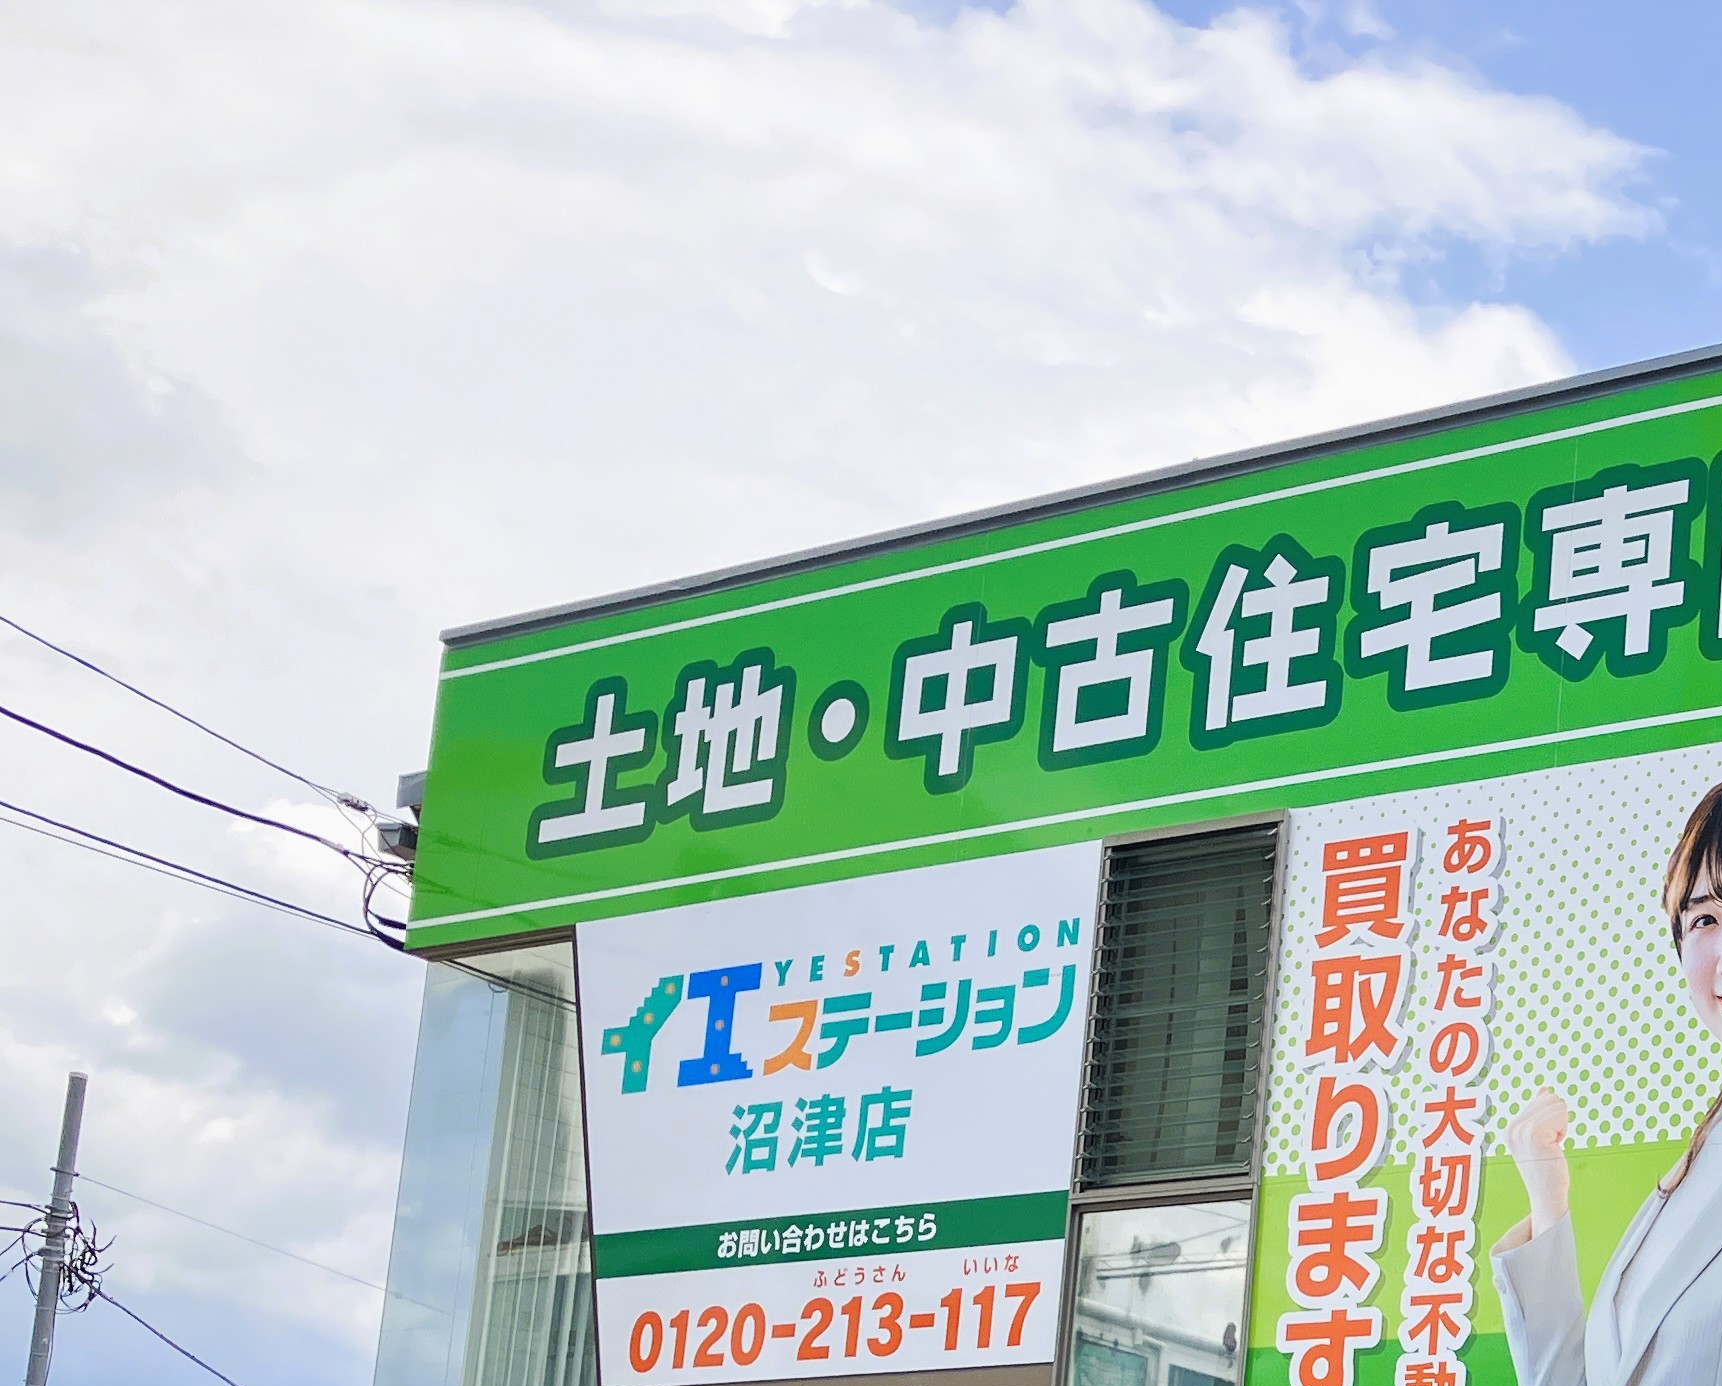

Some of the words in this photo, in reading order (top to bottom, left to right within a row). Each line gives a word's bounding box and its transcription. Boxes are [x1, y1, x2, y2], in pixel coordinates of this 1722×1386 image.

[724, 1085, 913, 1175] 沼津店
[716, 1212, 938, 1259] お問い合わせはこちら
[813, 1263, 907, 1288] ふどうさん
[962, 1253, 1020, 1277] いいな
[629, 1281, 1041, 1373] 0120-213-117
